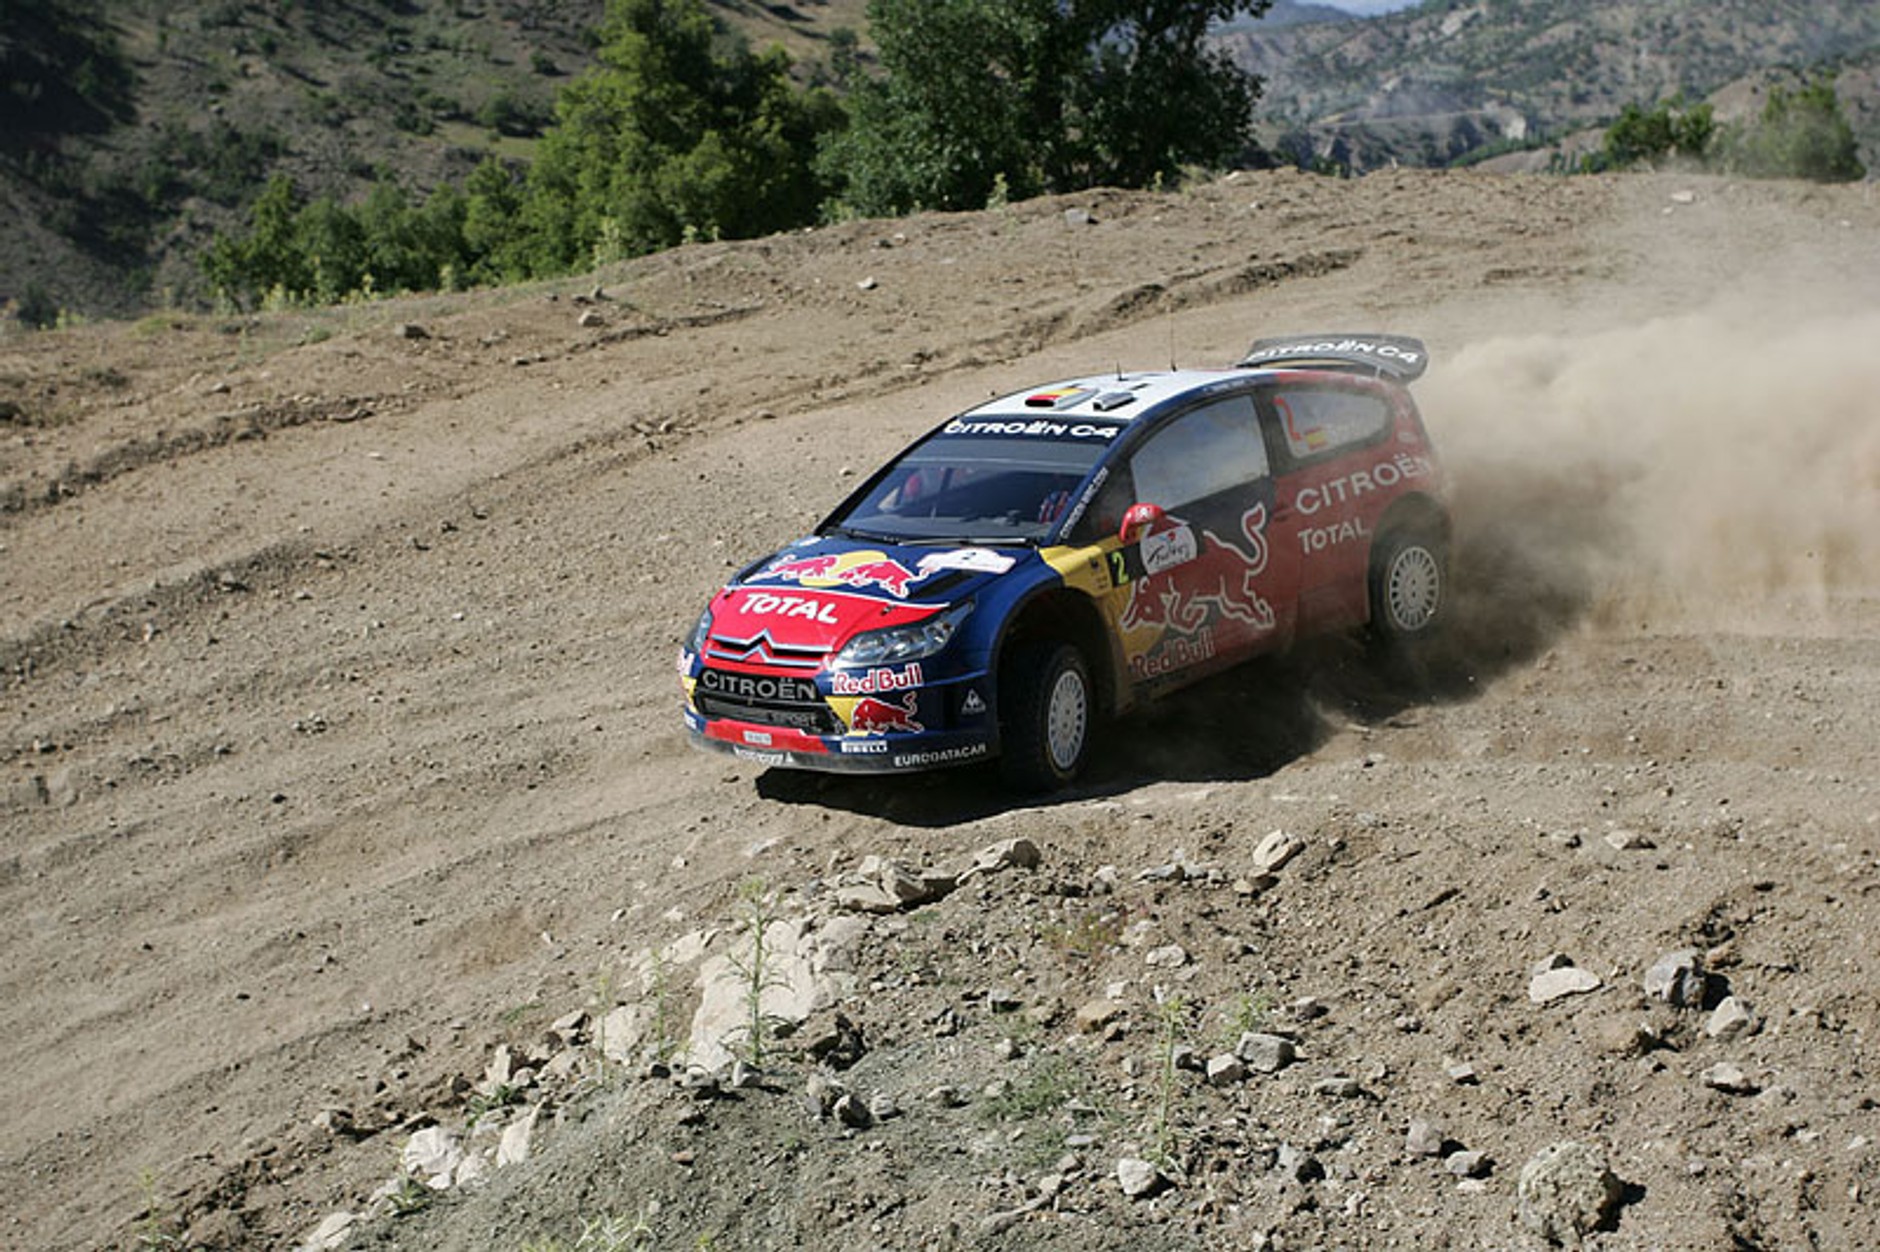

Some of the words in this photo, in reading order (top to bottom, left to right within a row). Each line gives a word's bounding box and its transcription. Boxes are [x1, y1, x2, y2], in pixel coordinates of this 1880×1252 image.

[1377, 345, 1418, 363] C4
[944, 419, 1068, 434] CITROËN
[1070, 425, 1120, 438] C4
[1297, 516, 1372, 555] TOTAL
[1112, 551, 1130, 584] 2
[740, 594, 838, 624] TOTAL
[1131, 637, 1174, 679] Red
[1175, 625, 1216, 667] Bull
[702, 669, 817, 700] CITROËN
[832, 669, 876, 694] Red
[877, 662, 923, 691] Bull
